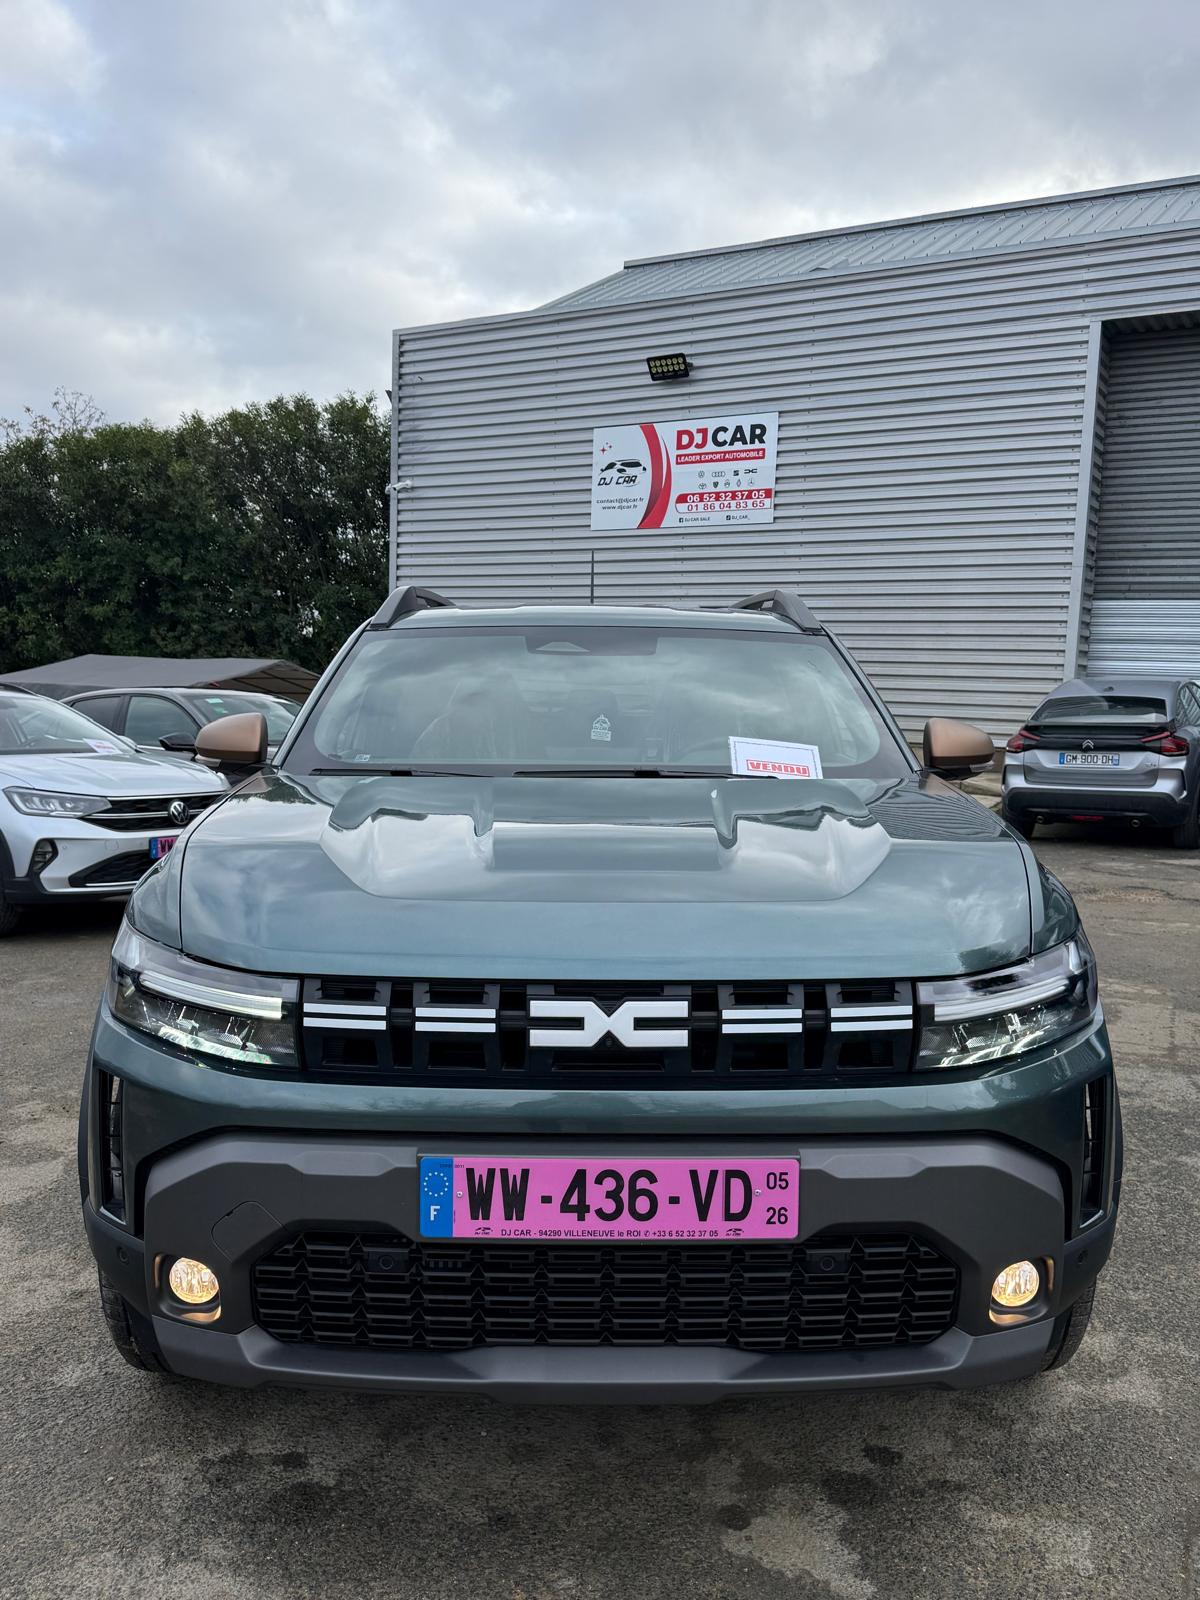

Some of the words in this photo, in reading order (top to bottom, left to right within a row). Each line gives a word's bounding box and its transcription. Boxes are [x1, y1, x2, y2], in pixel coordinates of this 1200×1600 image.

[676, 427, 708, 450] DJ
[712, 424, 767, 447] CAR
[678, 454, 700, 462] LEADER
[724, 450, 763, 459] AUTOMOBILE
[598, 476, 614, 486] DJ
[616, 475, 638, 485] CAR
[687, 494, 700, 502] 06
[703, 494, 716, 502] 52
[719, 493, 732, 501] 32
[735, 492, 748, 500] 37
[752, 490, 765, 499] 05
[750, 762, 807, 774] VENDU
[766, 1172, 789, 1190] 05
[430, 1205, 440, 1221] F
[766, 1206, 788, 1224] 26
[538, 1229, 561, 1237] 94290
